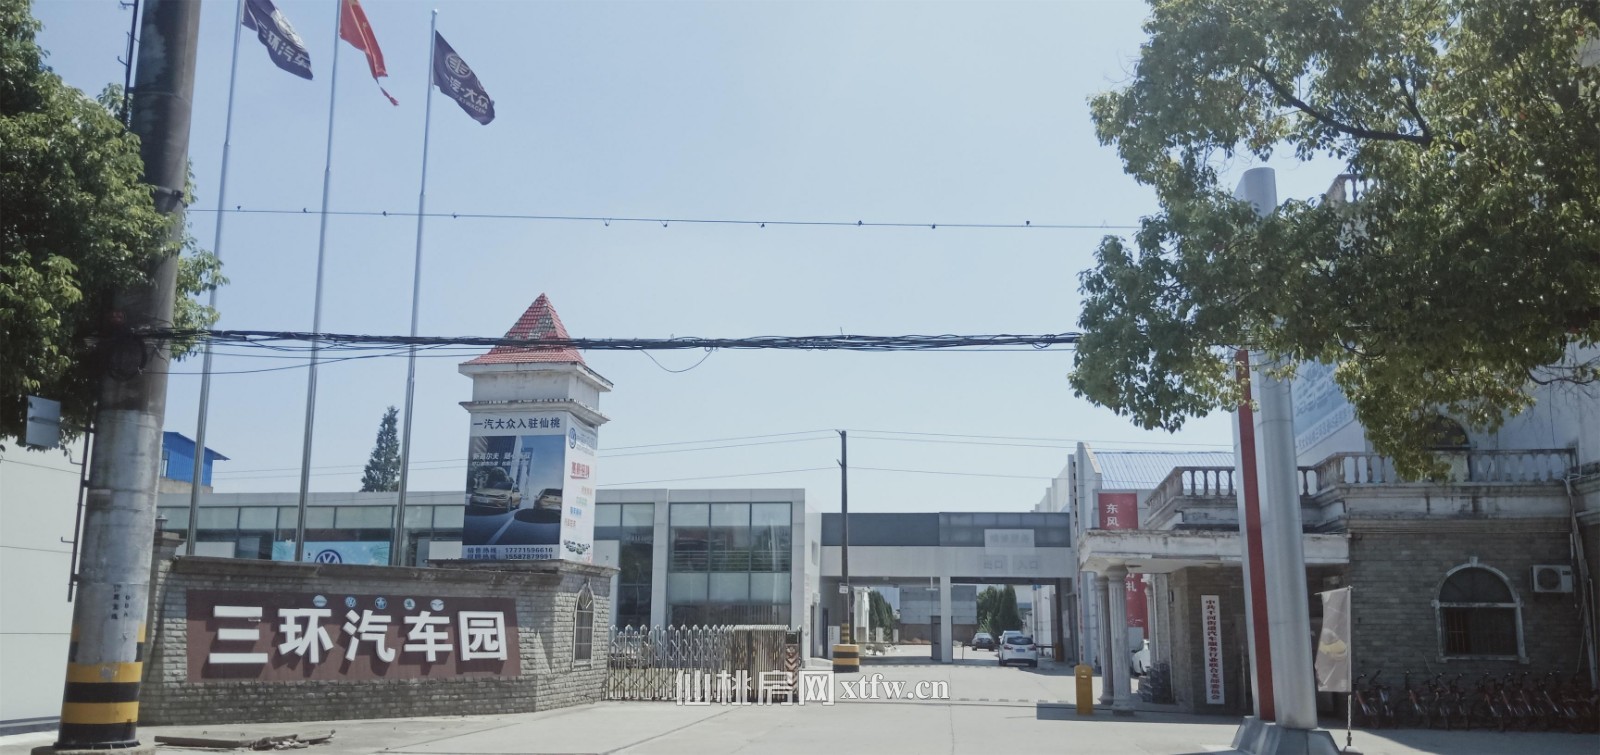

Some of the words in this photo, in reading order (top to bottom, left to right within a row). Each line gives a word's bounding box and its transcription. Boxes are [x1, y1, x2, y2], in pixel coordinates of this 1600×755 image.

[473, 417, 561, 430] 一汽大众入驻仙桃
[1105, 503, 1120, 527] 东风
[208, 605, 508, 663] 三环汽车园
